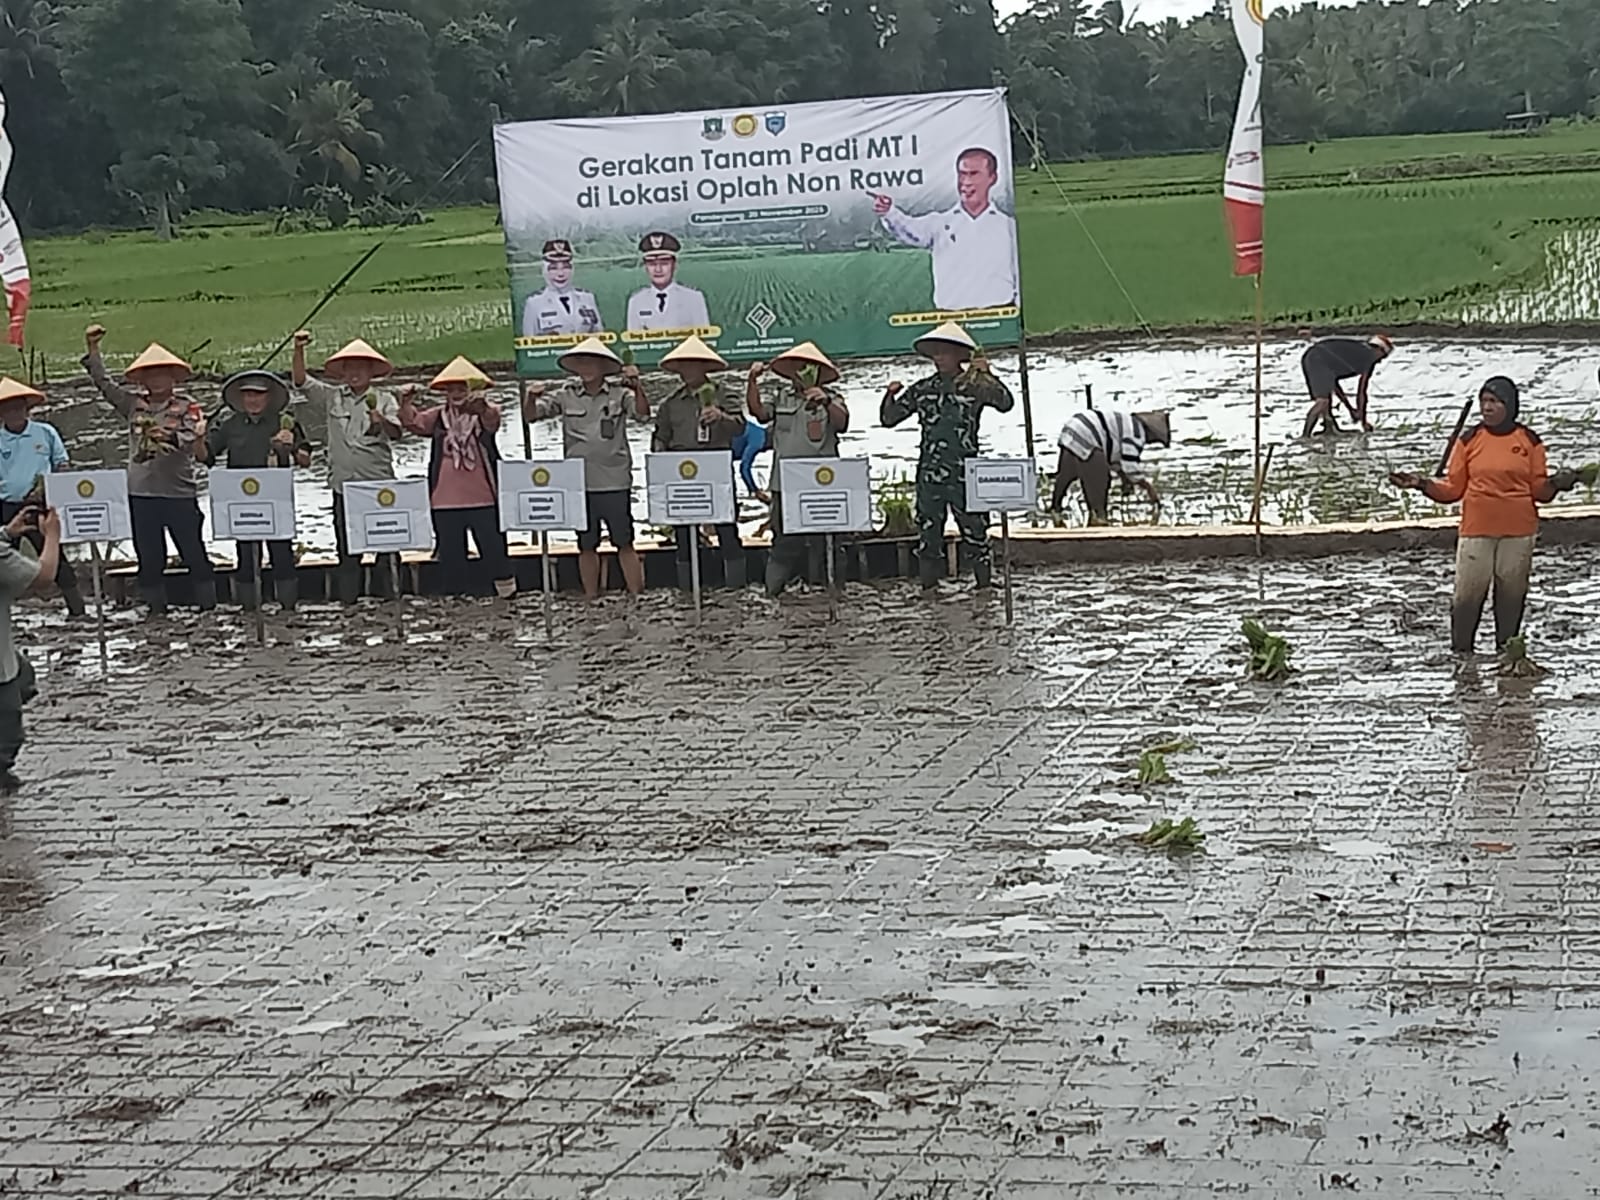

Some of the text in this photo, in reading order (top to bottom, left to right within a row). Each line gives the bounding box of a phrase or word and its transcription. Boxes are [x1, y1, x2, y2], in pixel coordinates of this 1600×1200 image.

[579, 134, 918, 179] Gerakan Tanam Padi MT I
[577, 168, 924, 208] di Lokasi Oplah Non Rawa
